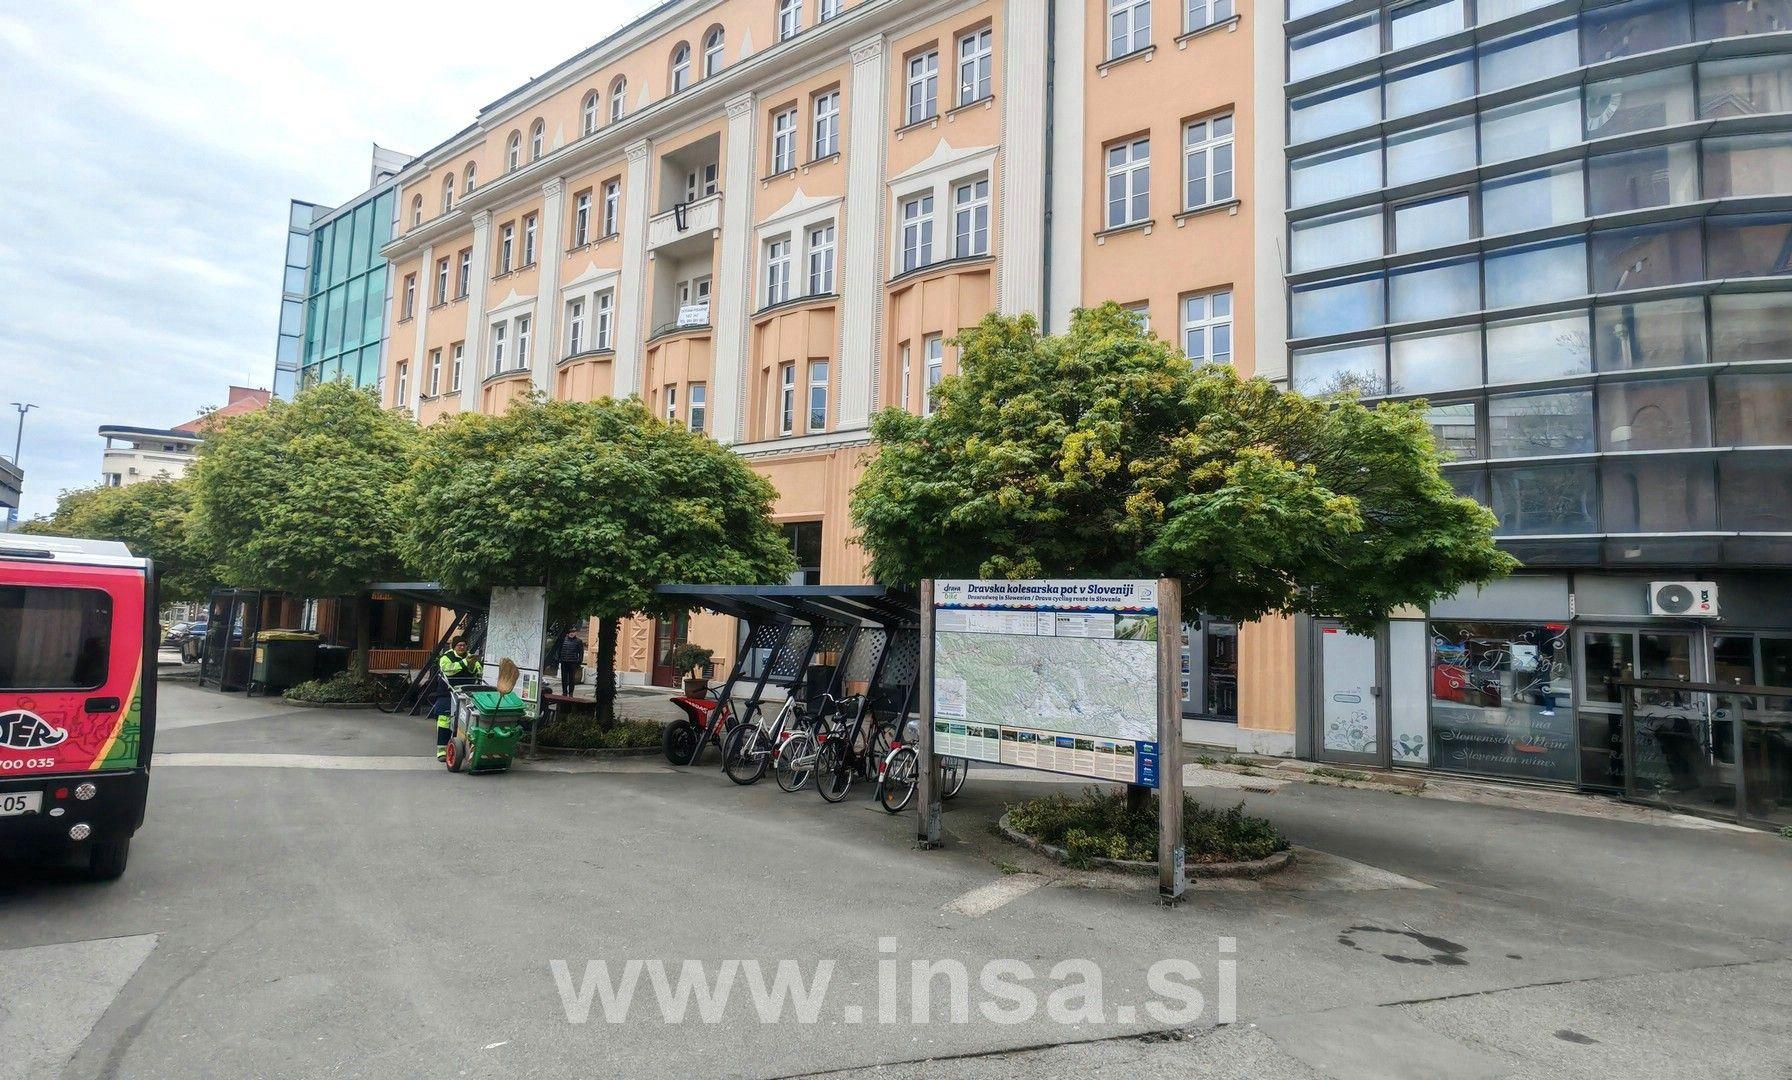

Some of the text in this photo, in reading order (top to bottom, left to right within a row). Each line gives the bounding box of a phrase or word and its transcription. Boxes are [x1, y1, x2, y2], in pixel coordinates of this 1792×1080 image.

[968, 583, 1134, 597] Dravska kolesarska pot v Sloveniji
[1053, 595, 1073, 603] cycling
[1451, 746, 1517, 765] Slovenian
[27, 758, 55, 769] 035
